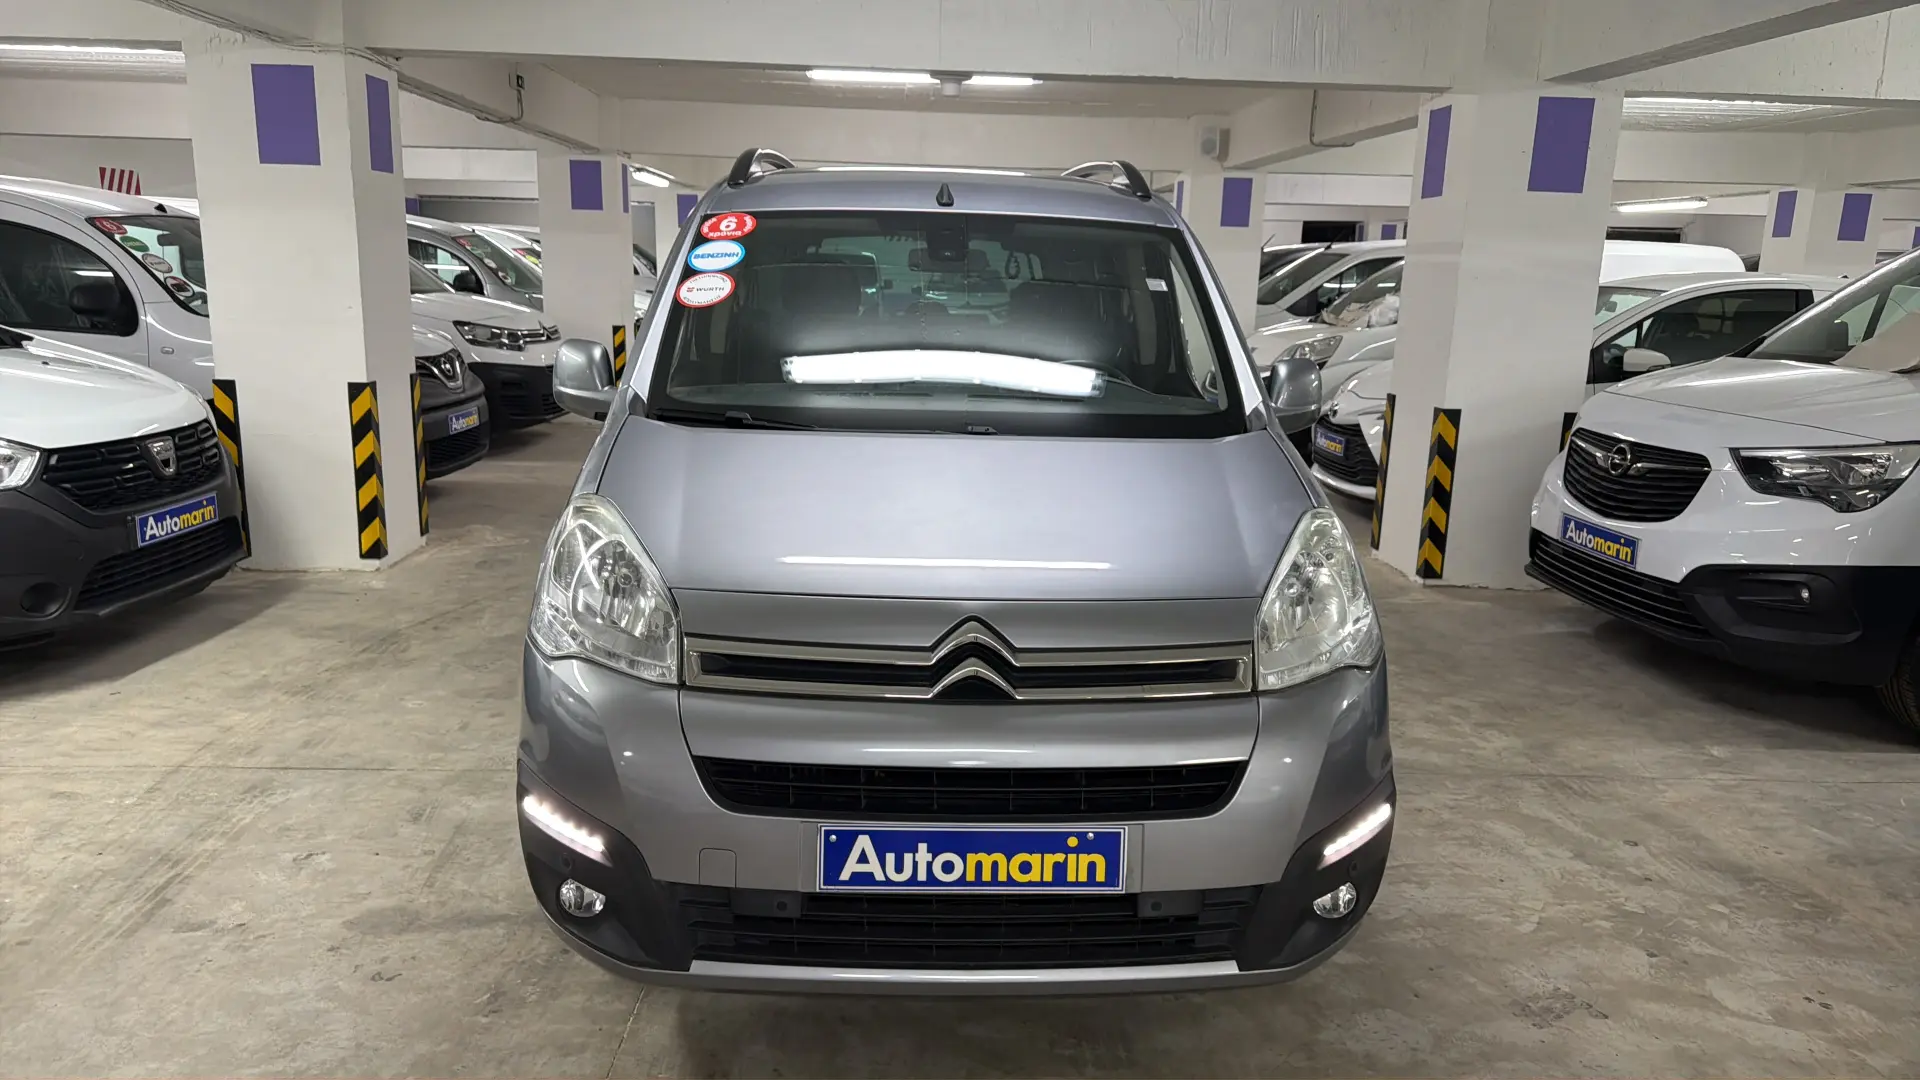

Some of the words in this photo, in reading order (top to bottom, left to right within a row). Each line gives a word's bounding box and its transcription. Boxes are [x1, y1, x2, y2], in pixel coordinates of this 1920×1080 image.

[719, 218, 738, 231] 6
[145, 499, 214, 541] Automarin
[1565, 520, 1632, 563] Automarin
[838, 834, 1106, 883] Automarin
